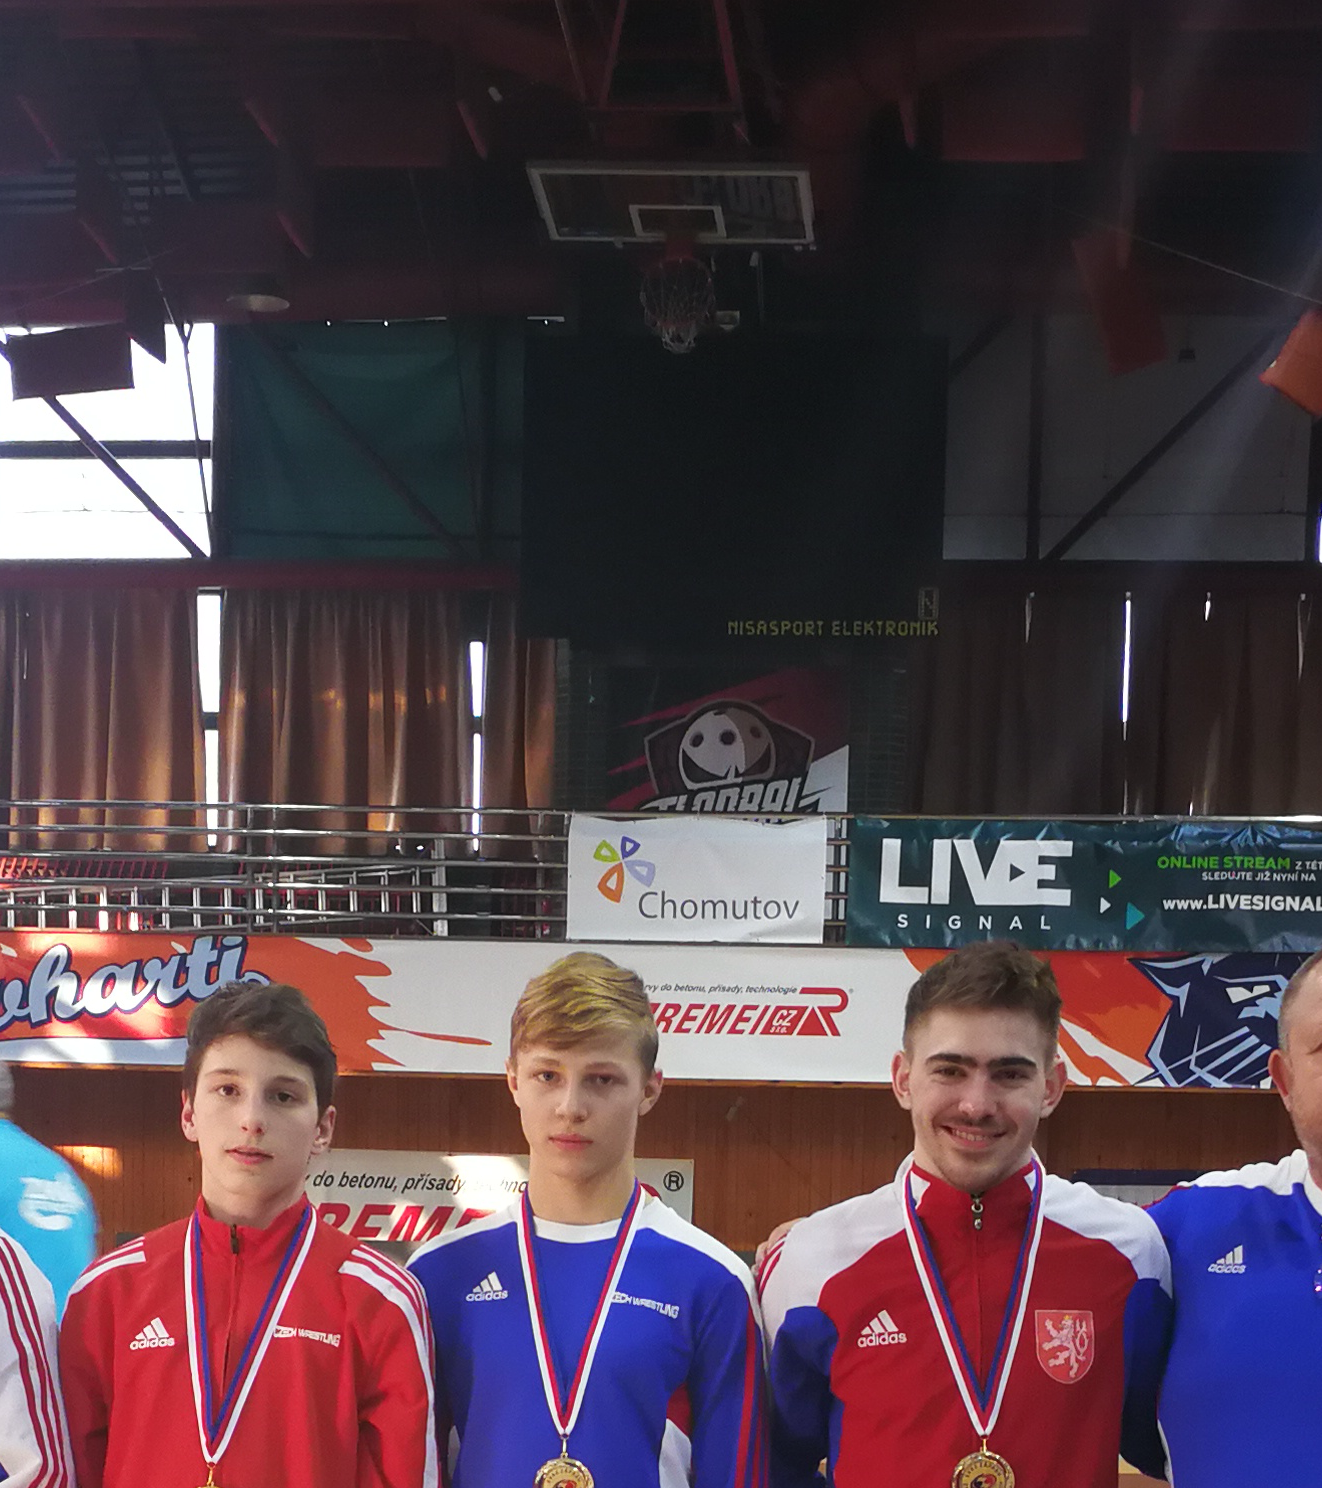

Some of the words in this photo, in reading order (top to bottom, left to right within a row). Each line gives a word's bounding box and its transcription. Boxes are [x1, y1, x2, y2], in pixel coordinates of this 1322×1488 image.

[727, 620, 824, 636] NISASPORT
[831, 620, 939, 636] ELEKTRONIK
[1157, 856, 1219, 869] ONLINE
[1223, 856, 1290, 870] STREAM
[1295, 861, 1302, 870] Z
[879, 838, 1074, 906] LIVE
[1202, 871, 1253, 881] SLEDUJTE
[1273, 871, 1299, 882] NYNÍ
[1301, 873, 1317, 882] NA
[638, 890, 800, 920] Chomutov
[897, 914, 1052, 930] SIGNAL
[661, 983, 672, 991] do
[674, 983, 706, 992] betonu,
[745, 985, 798, 995] technologie
[772, 1009, 797, 1026] CZ
[313, 1171, 334, 1188] do
[338, 1172, 397, 1192] betonu,
[465, 1289, 508, 1302] adidas
[129, 1336, 175, 1350] adidas
[857, 1331, 907, 1348] adidas
